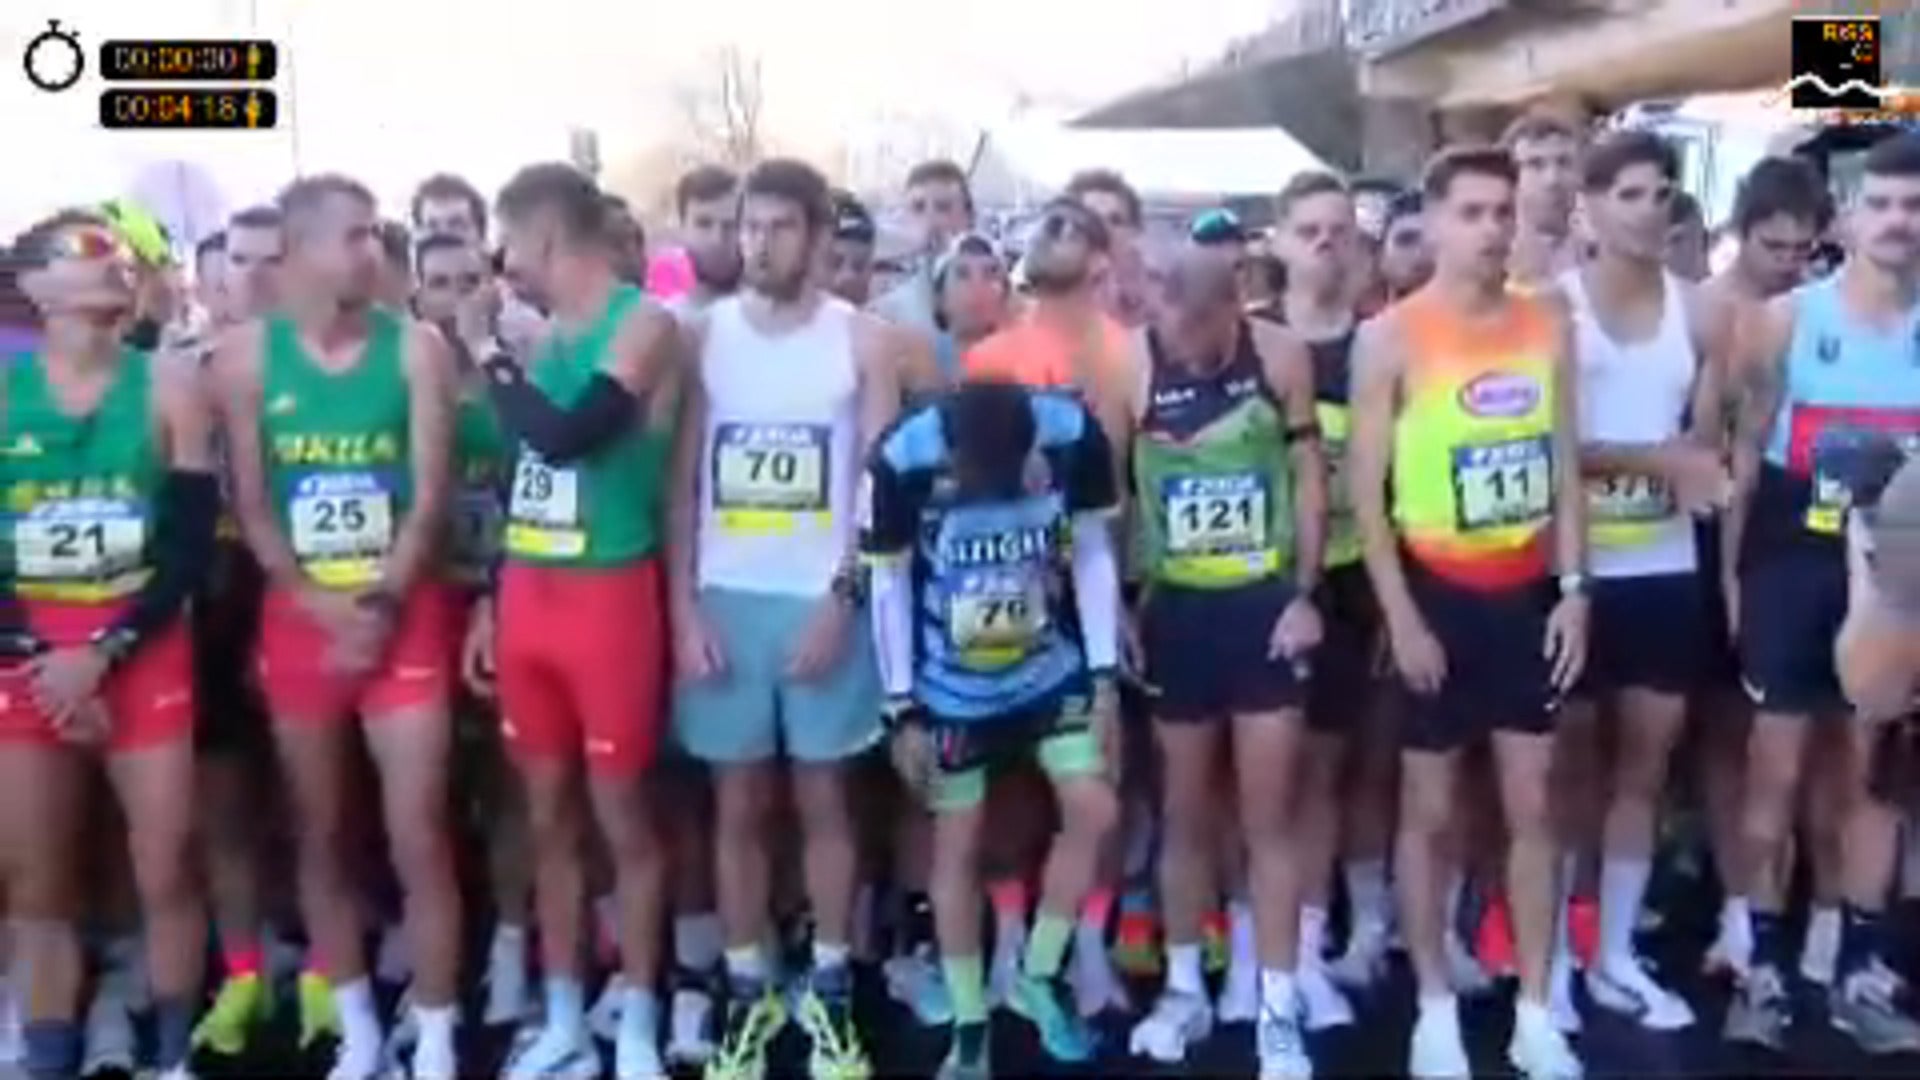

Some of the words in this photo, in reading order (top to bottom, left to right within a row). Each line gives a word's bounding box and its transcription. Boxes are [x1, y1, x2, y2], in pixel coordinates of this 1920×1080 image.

[519, 463, 553, 502] 29
[745, 450, 798, 484] 70
[1485, 466, 1530, 500] 11
[313, 498, 367, 533] 25
[1178, 498, 1253, 531] 121
[47, 521, 106, 558] 21
